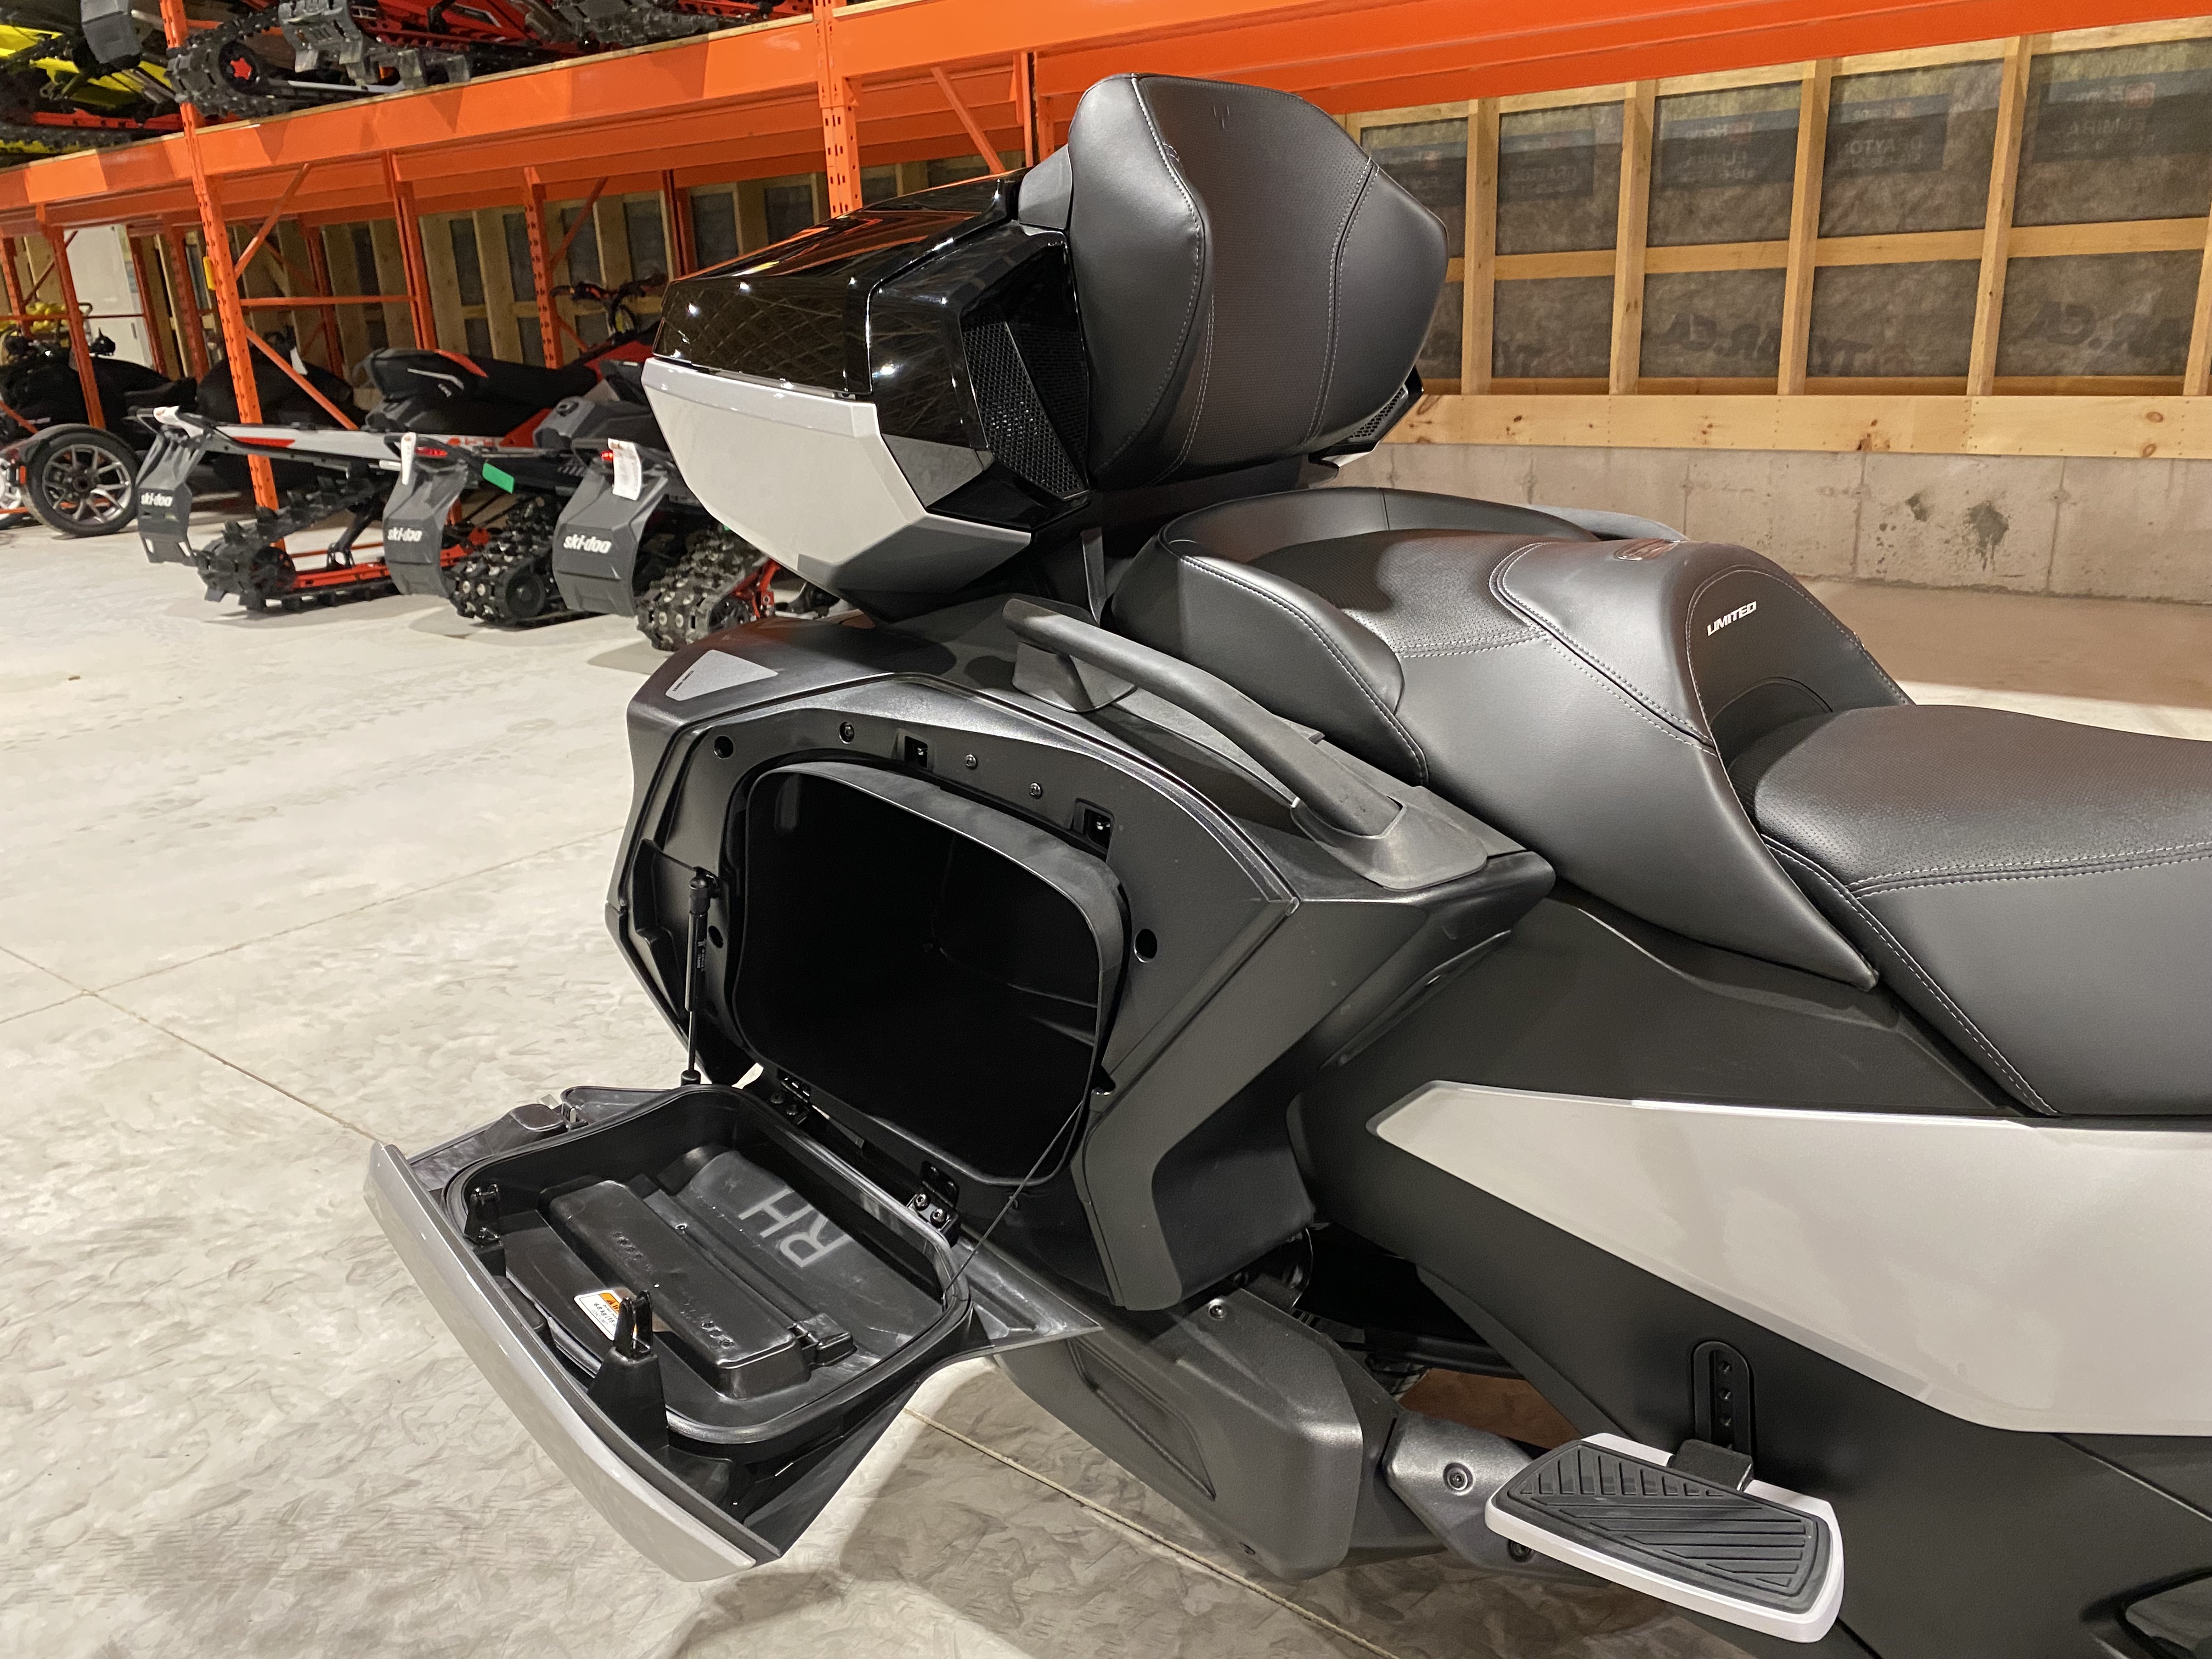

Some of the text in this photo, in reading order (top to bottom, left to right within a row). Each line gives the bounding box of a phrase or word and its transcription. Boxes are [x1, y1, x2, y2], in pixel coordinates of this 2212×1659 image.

[140, 492, 173, 507] ski-doo
[387, 527, 422, 542] ski-doo
[563, 533, 612, 554] ski-doo
[1707, 601, 1757, 636] LIMITED
[738, 1187, 854, 1268] RH
